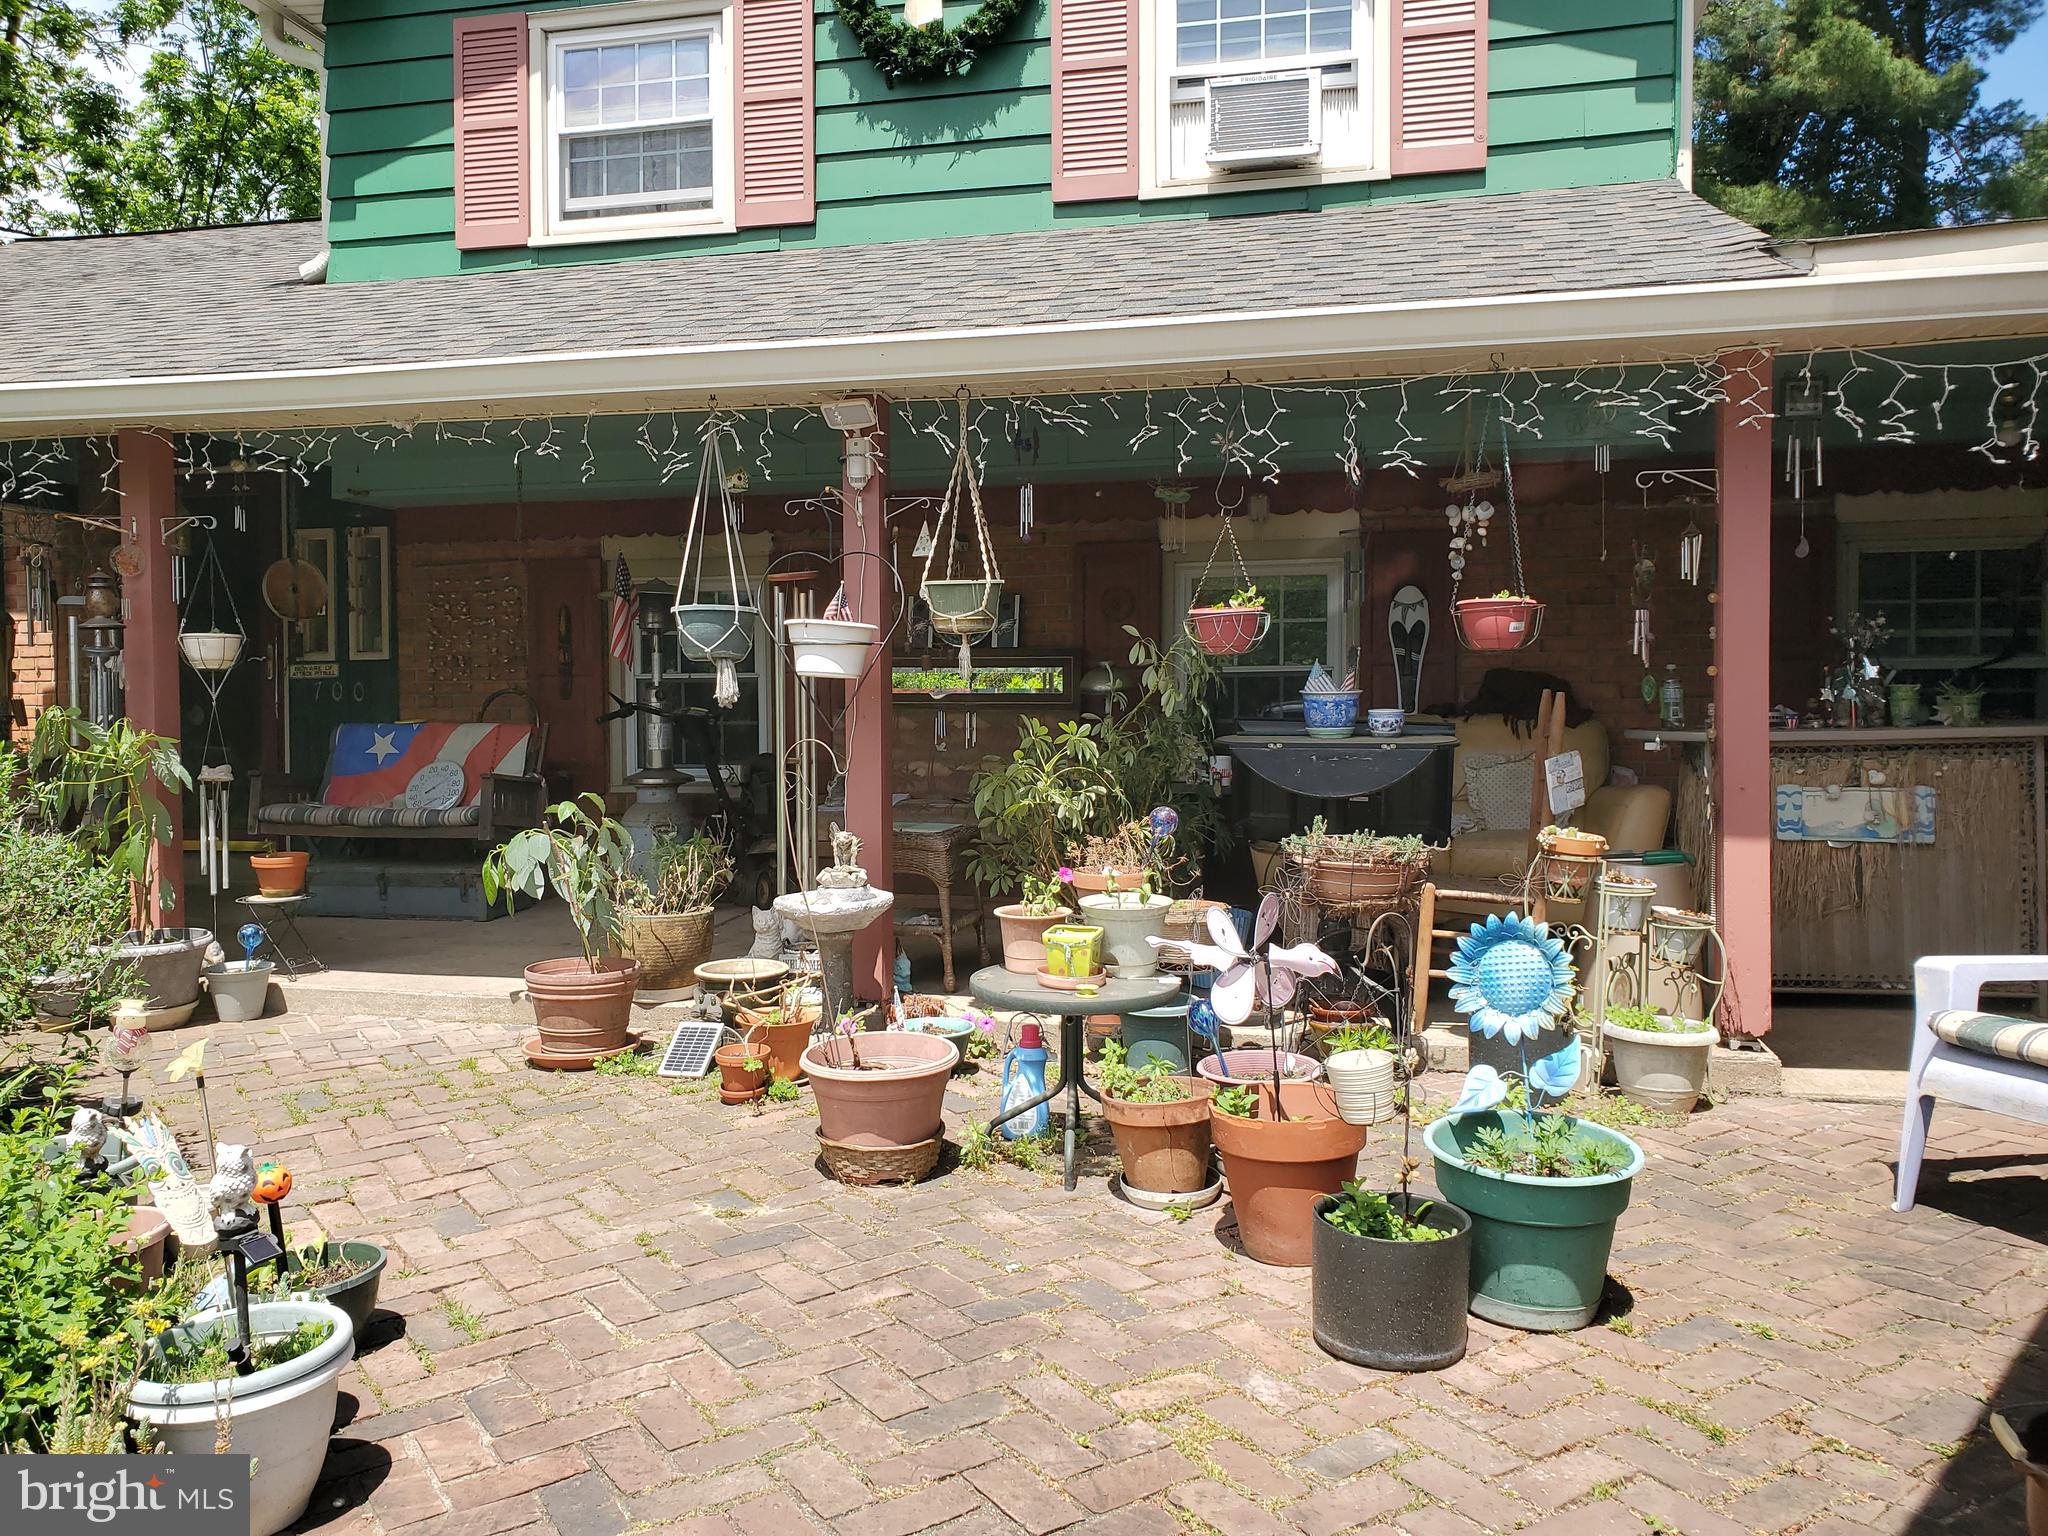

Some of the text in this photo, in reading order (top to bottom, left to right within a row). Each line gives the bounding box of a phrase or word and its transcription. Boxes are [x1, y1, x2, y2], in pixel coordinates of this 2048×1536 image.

[1240, 75, 1278, 83] FRIGIDAIRE
[314, 681, 364, 702] 700
[450, 769, 459, 777] 60
[452, 779, 460, 787] 80
[447, 788, 460, 797] 100
